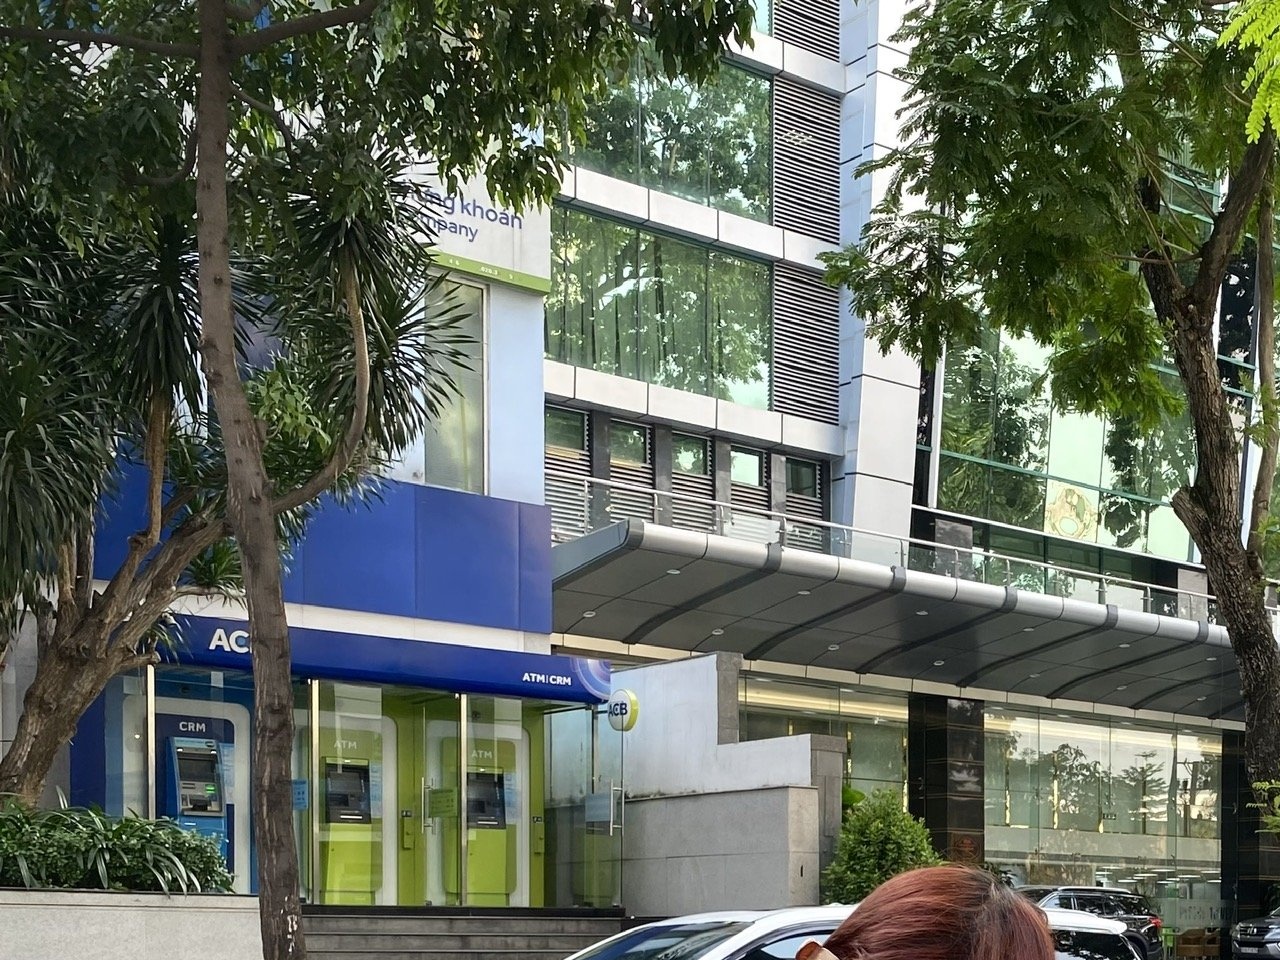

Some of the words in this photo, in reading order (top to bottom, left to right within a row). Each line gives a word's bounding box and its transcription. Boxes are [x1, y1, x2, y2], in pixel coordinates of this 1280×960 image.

[208, 628, 253, 655] AC
[608, 702, 629, 717] ACB
[178, 721, 206, 734] CRM
[333, 739, 358, 750] ATM
[470, 749, 493, 760] ATM
